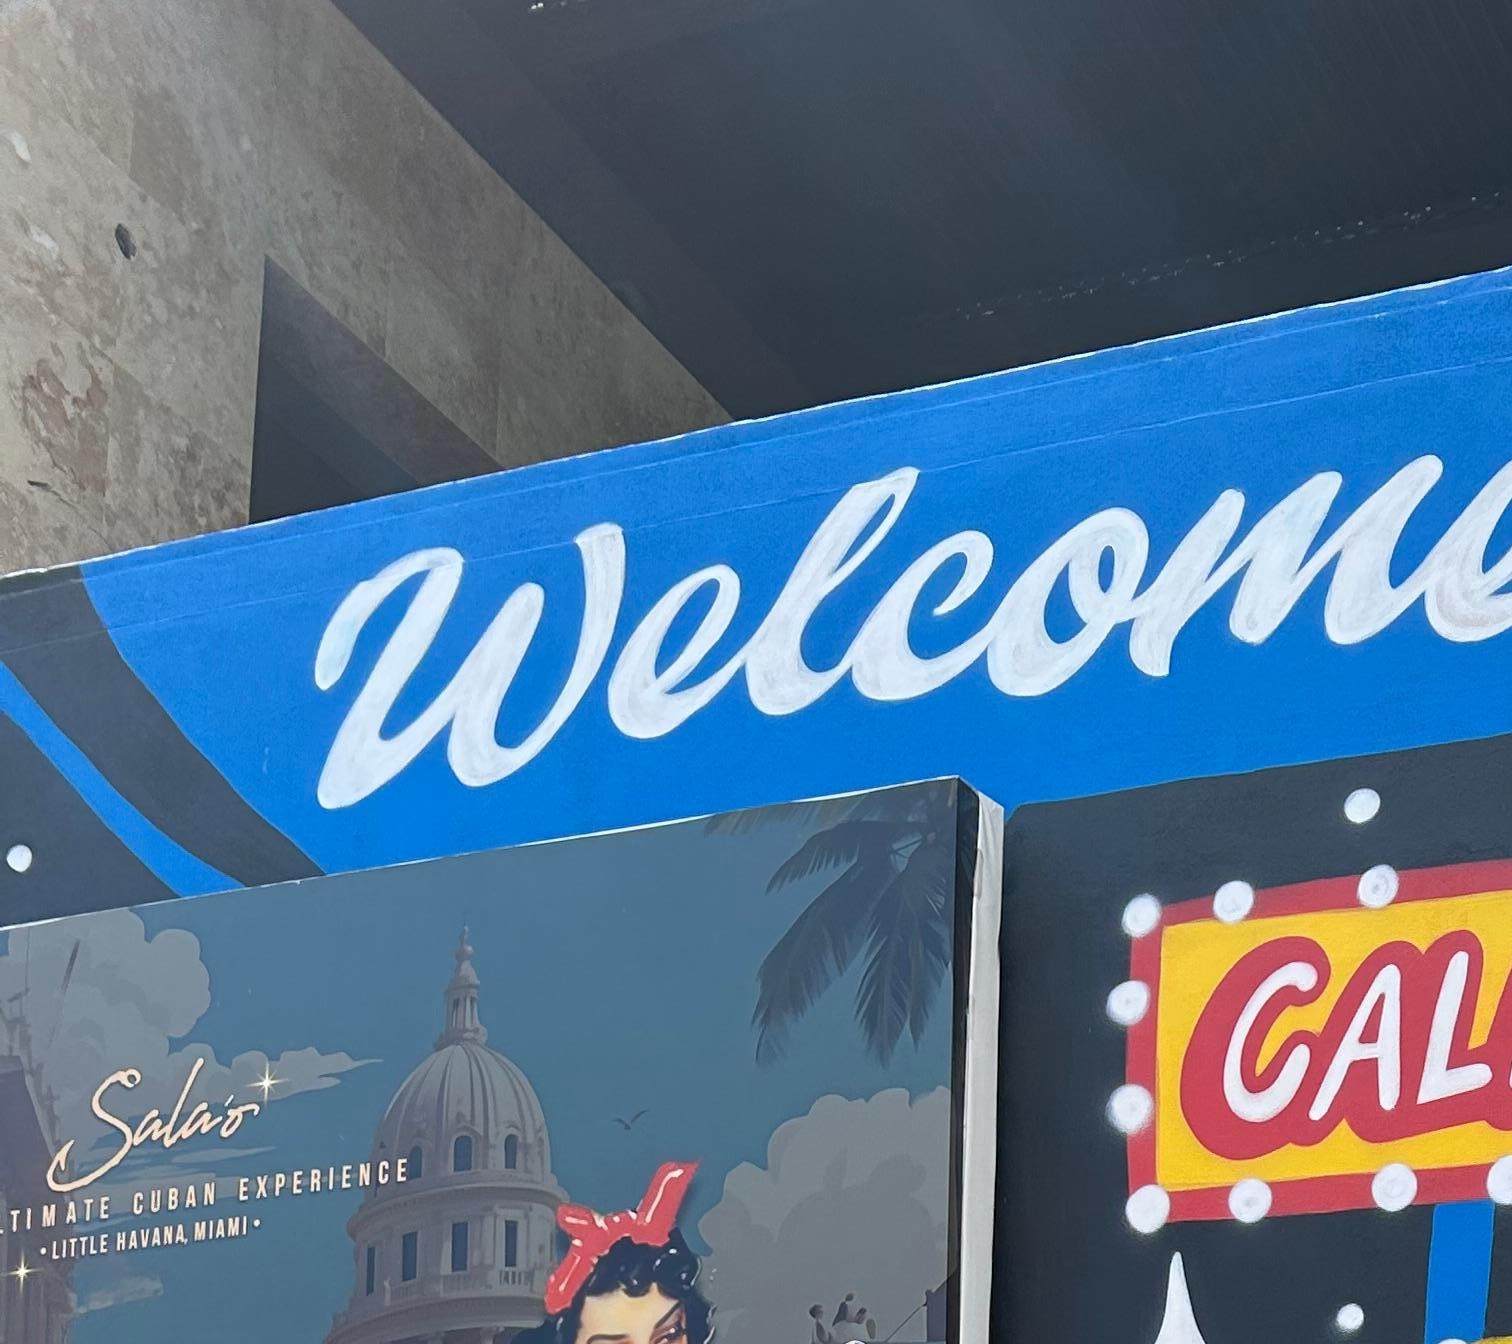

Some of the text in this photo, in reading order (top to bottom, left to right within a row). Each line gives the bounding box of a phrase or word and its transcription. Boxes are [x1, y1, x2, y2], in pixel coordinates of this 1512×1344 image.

[0, 1157, 409, 1235] TIMATE CUBAN EXPERIENCE
[51, 1215, 248, 1259] LITTLE HAVANA, MIAMI
